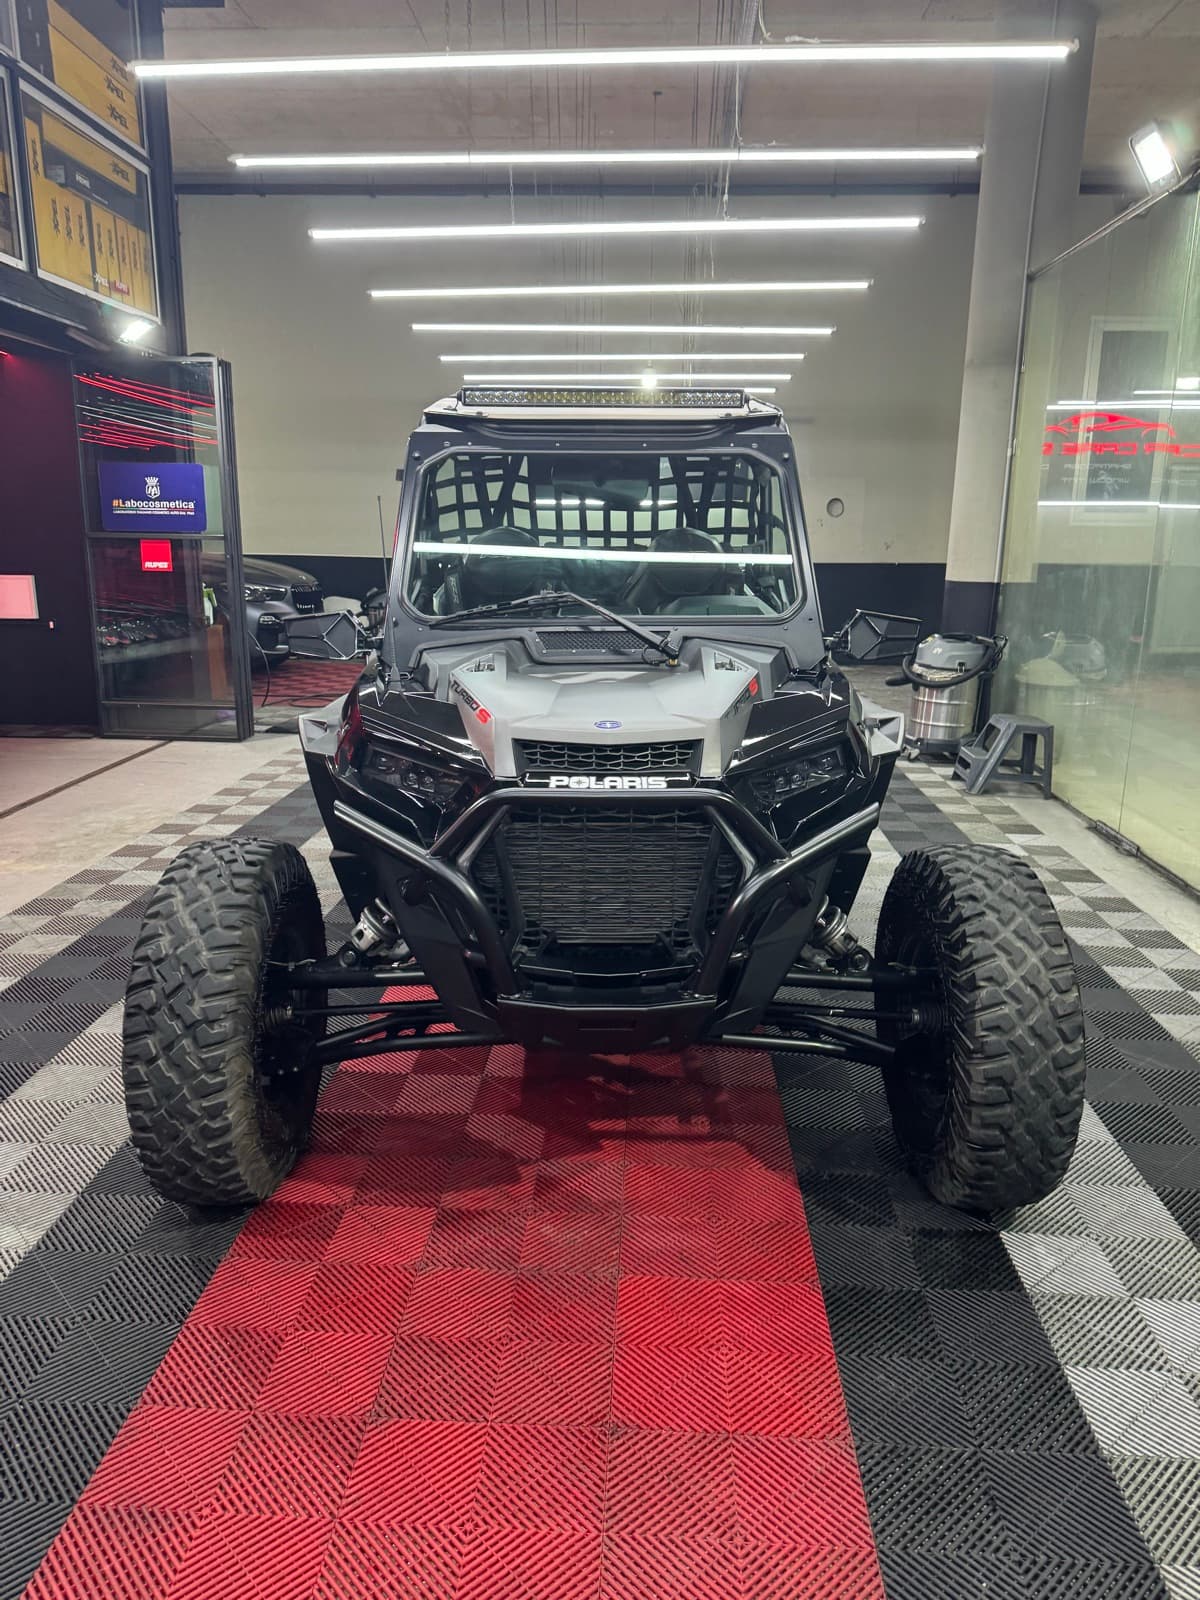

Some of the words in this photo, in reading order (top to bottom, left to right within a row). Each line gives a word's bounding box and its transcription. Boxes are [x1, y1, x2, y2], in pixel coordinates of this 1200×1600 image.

[107, 104, 129, 129] XPEL
[109, 159, 130, 182] XPEL
[112, 499, 194, 508] #Labocosmetica
[451, 679, 481, 712] TURBO
[475, 708, 491, 724] S
[548, 775, 668, 789] POLARIS
